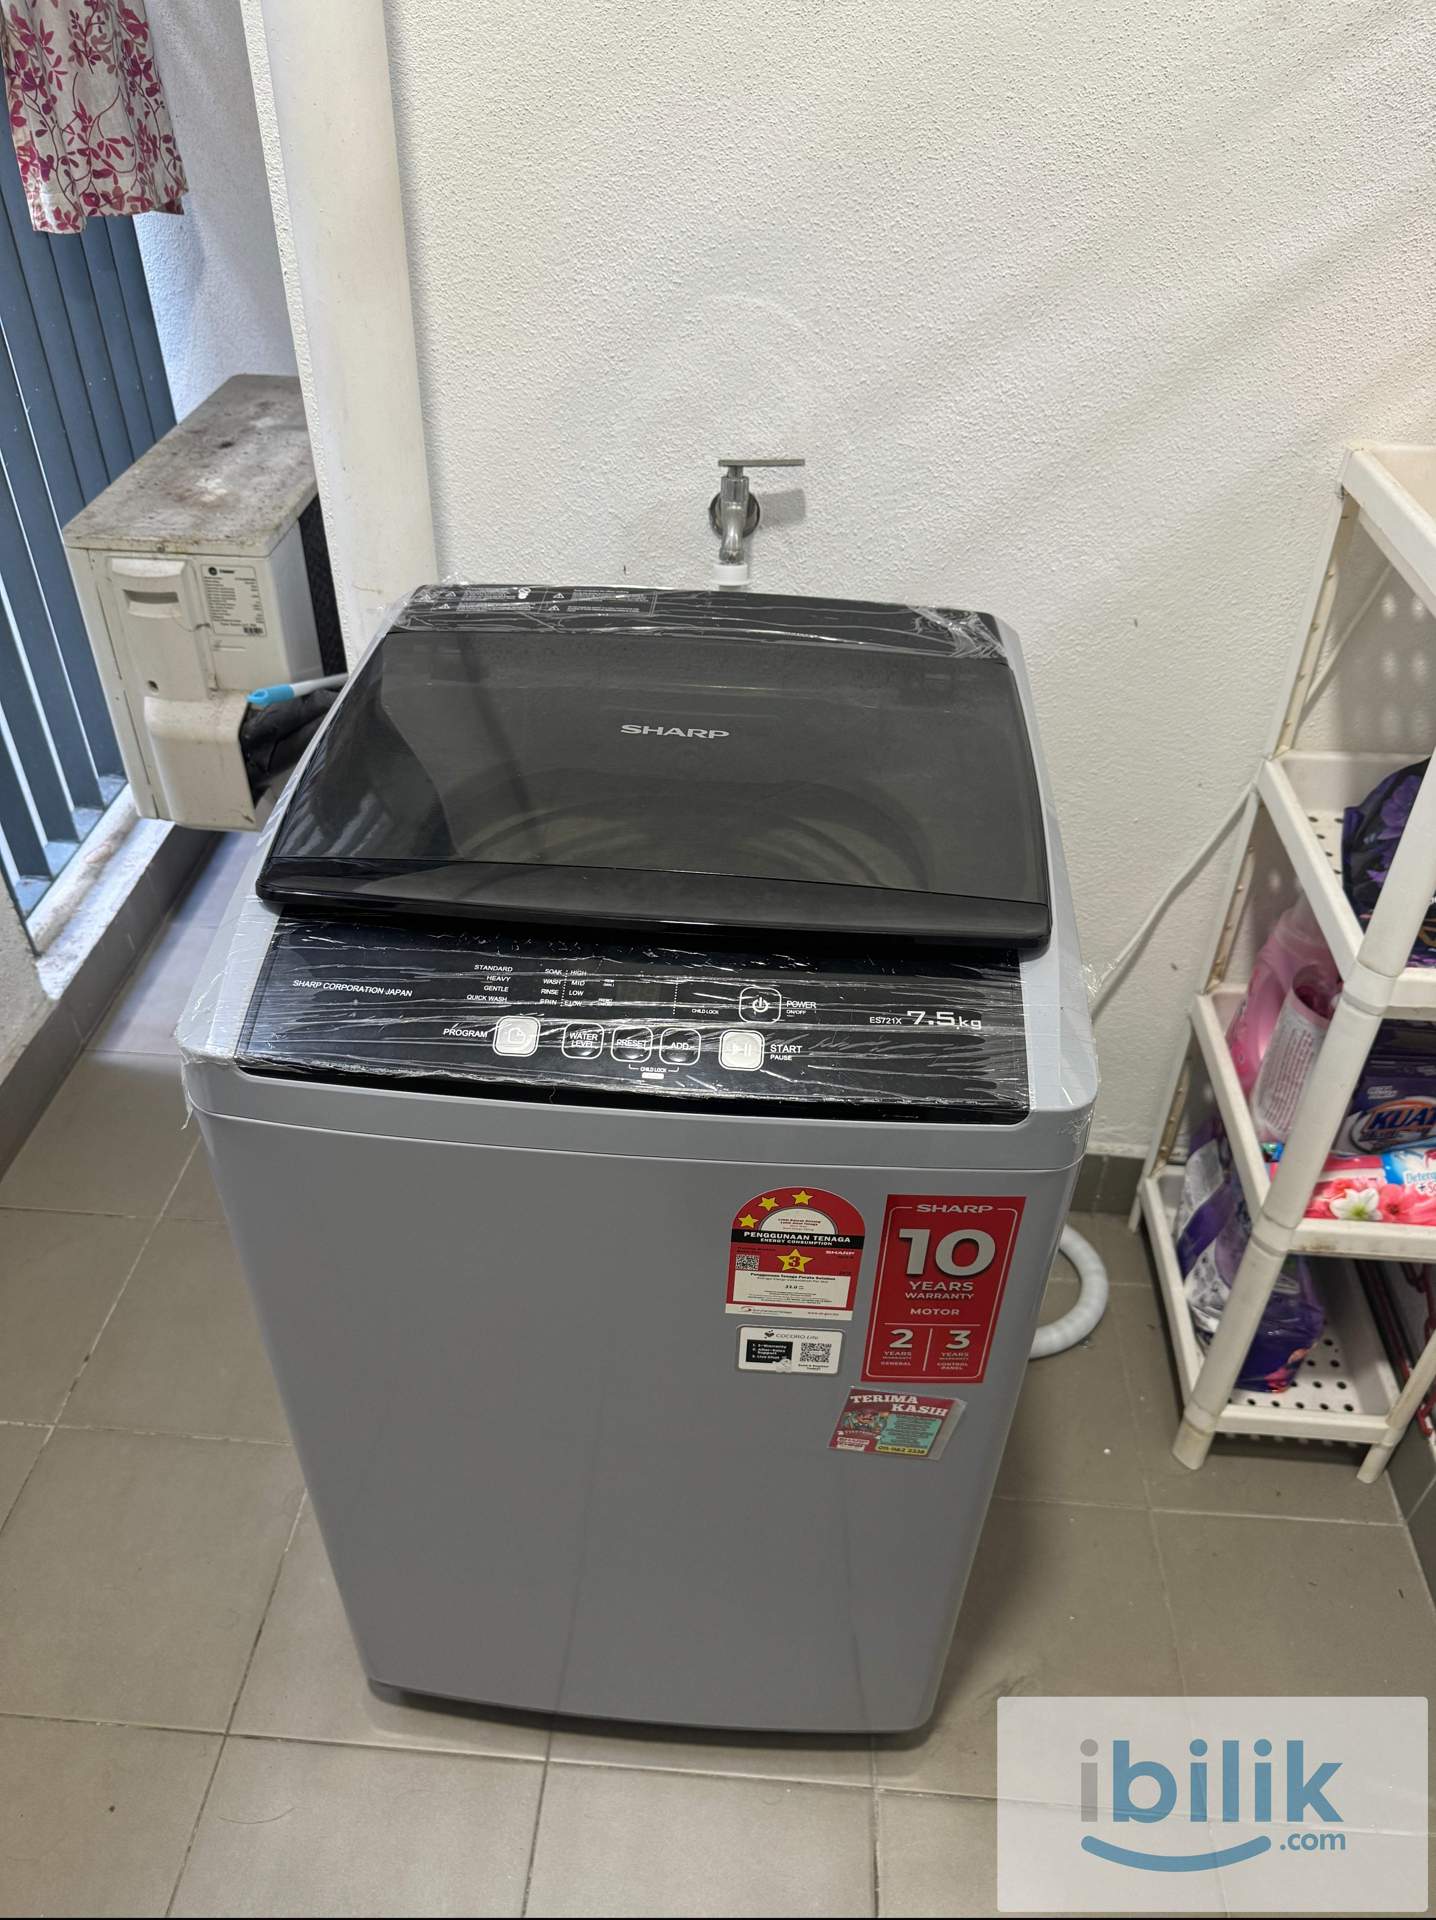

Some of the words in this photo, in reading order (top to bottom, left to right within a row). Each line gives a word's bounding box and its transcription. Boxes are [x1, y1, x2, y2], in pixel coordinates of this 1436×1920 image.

[620, 724, 730, 739] SHARP
[474, 964, 513, 973] STANDARD
[544, 968, 563, 976] SOAK
[486, 975, 511, 983] HEAVY
[543, 978, 562, 986] WASH
[292, 979, 323, 989] SHARP
[322, 982, 385, 996] CORPORATION
[384, 988, 413, 998] JAPAN
[483, 985, 509, 993] GENTLE
[540, 988, 560, 996] RINSE
[466, 994, 488, 1002] QUICK
[786, 1000, 817, 1010] POWER
[869, 1016, 903, 1026] ES721X
[442, 1027, 489, 1039] PROGRAM
[569, 1031, 599, 1042] WATER
[571, 1040, 594, 1049] LEVEL
[616, 1039, 649, 1050] PRESET
[769, 1043, 803, 1055] START
[769, 1053, 794, 1062] PAUSE
[916, 1203, 994, 1215] SHARP
[743, 1230, 811, 1242] PENGGUNAAN
[812, 1235, 852, 1244] TENAGA
[786, 1239, 834, 1247] CONSUMPTION
[898, 1227, 997, 1278] 10
[909, 1280, 975, 1292] YEARS
[904, 1291, 976, 1301] WARRANTY
[909, 1307, 961, 1317] MOTOR
[888, 1328, 915, 1350] 2
[945, 1329, 972, 1351] 3
[850, 1394, 919, 1405] TERIMA
[891, 1403, 949, 1417] KASIH
